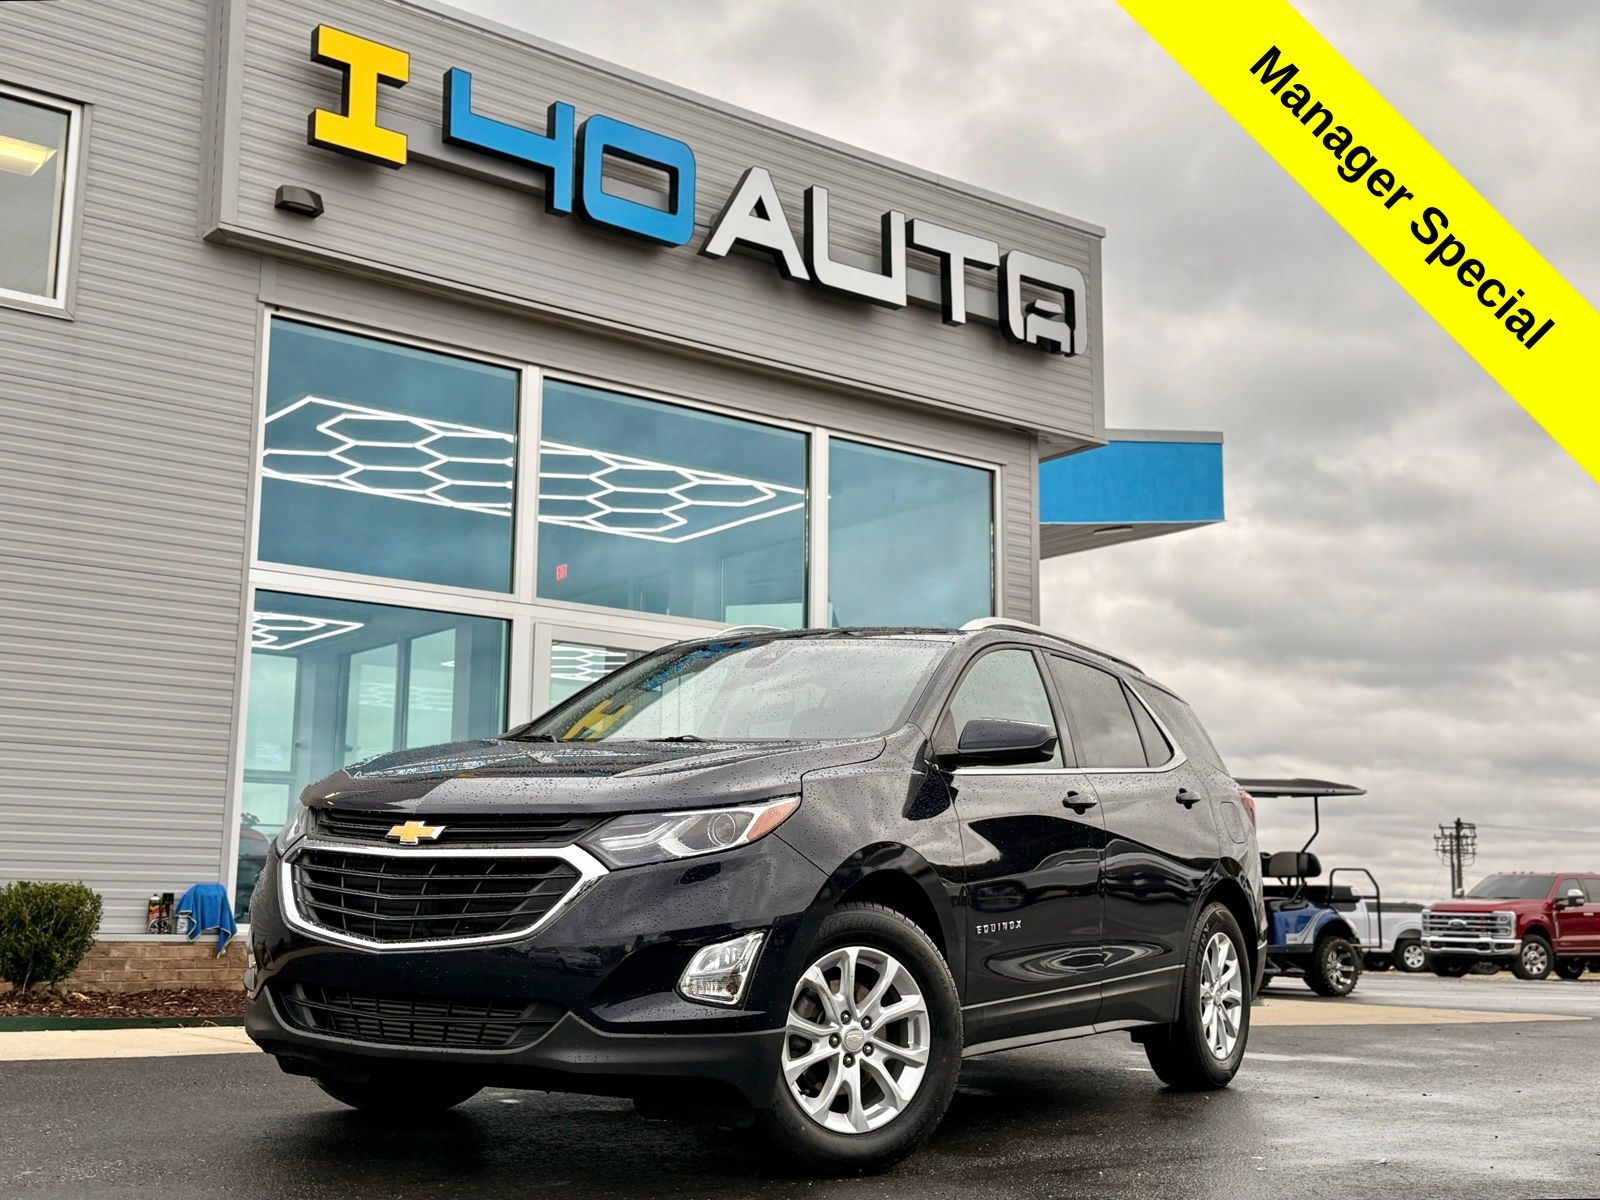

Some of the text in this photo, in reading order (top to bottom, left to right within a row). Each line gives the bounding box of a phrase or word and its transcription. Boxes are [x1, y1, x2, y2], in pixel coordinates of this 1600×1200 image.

[308, 24, 1088, 357] I 40 AUTO
[976, 919, 1022, 935] EQUINOX
